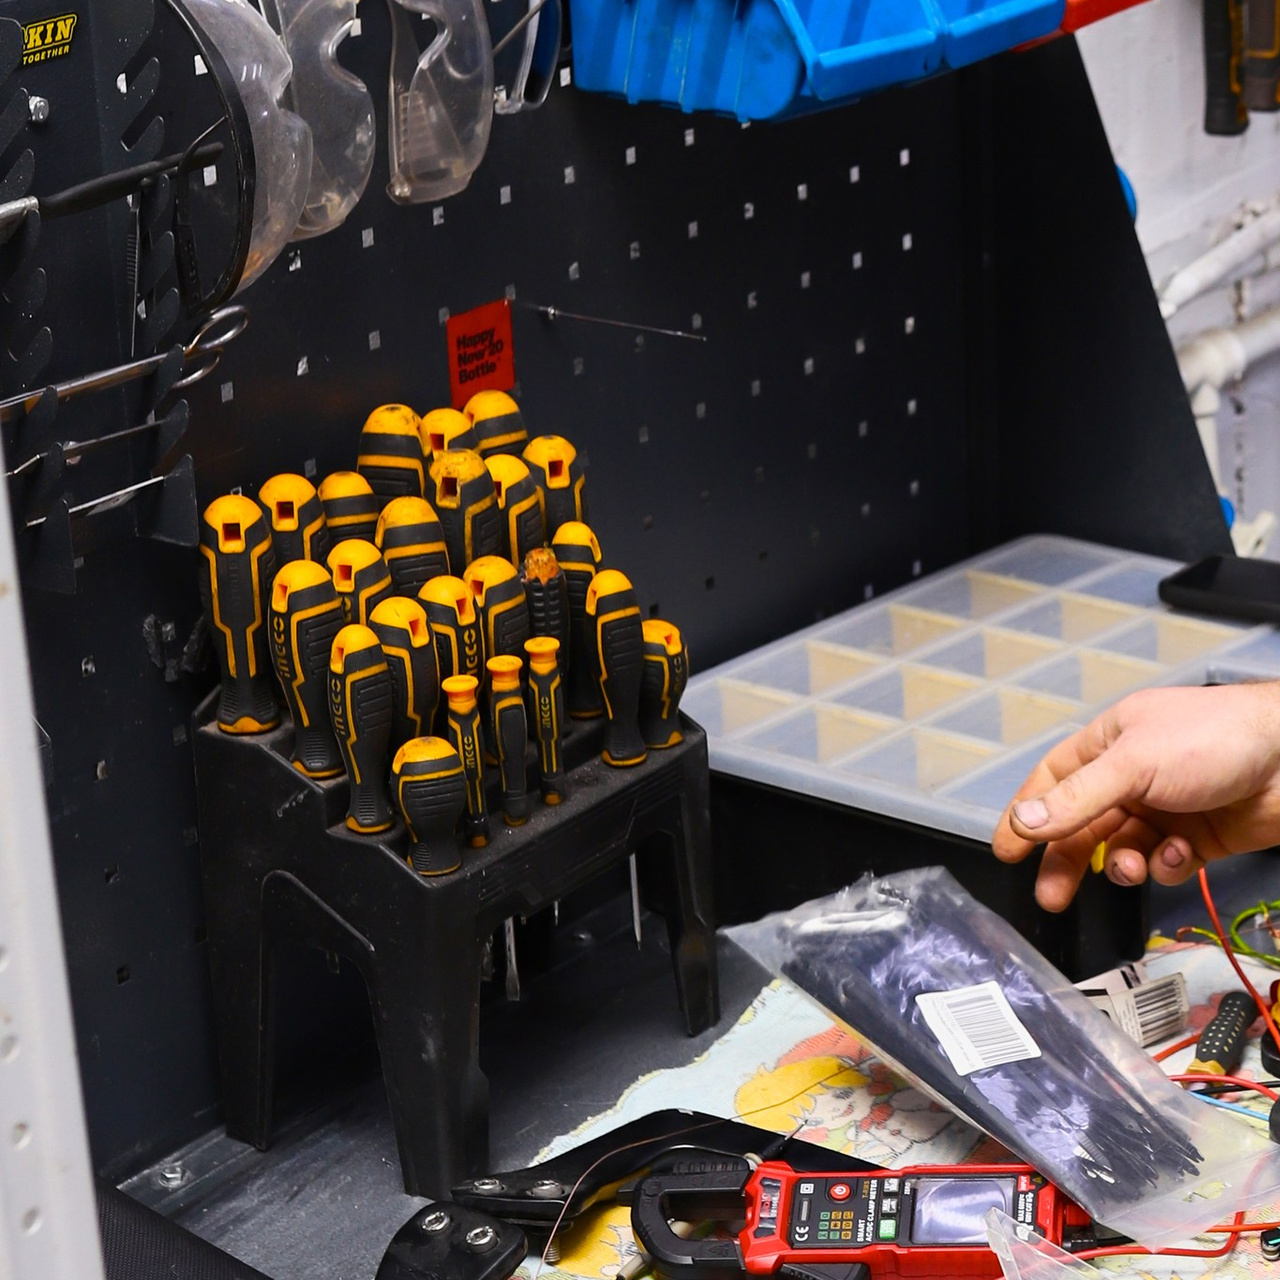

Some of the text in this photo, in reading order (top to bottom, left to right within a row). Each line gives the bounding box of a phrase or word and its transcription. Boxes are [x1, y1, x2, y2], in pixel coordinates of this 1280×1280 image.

[23, 44, 70, 65] TOGETHER
[457, 327, 495, 351] Happy
[459, 360, 497, 385] Bottle
[865, 1179, 878, 1242] AC/DC CLAMP METER
[857, 1218, 866, 1242] SMART
